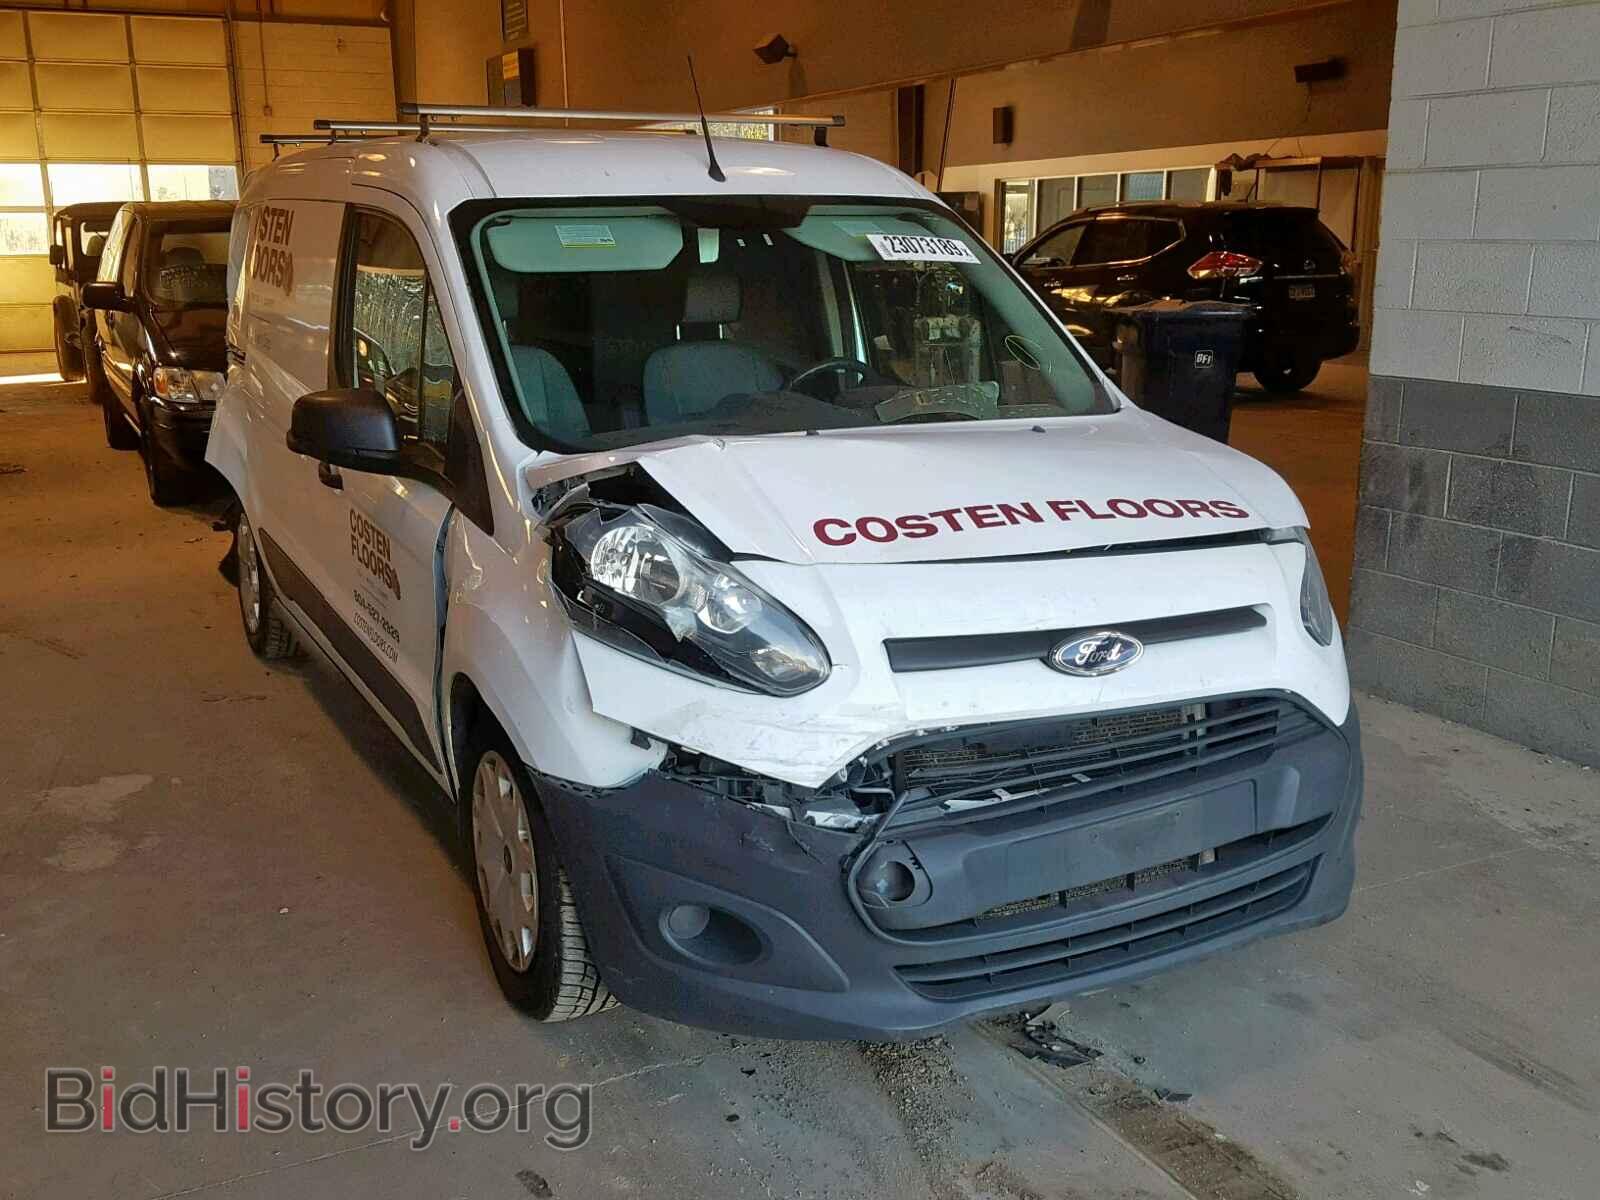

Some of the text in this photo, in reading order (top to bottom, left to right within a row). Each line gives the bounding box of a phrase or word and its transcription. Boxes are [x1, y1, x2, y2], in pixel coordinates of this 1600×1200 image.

[882, 235, 963, 256] 23073189
[350, 509, 391, 562] COSTEN
[813, 498, 1250, 546] COSTEN FLOORS
[351, 533, 392, 589] FLOORS
[1075, 641, 1121, 665] Ford
